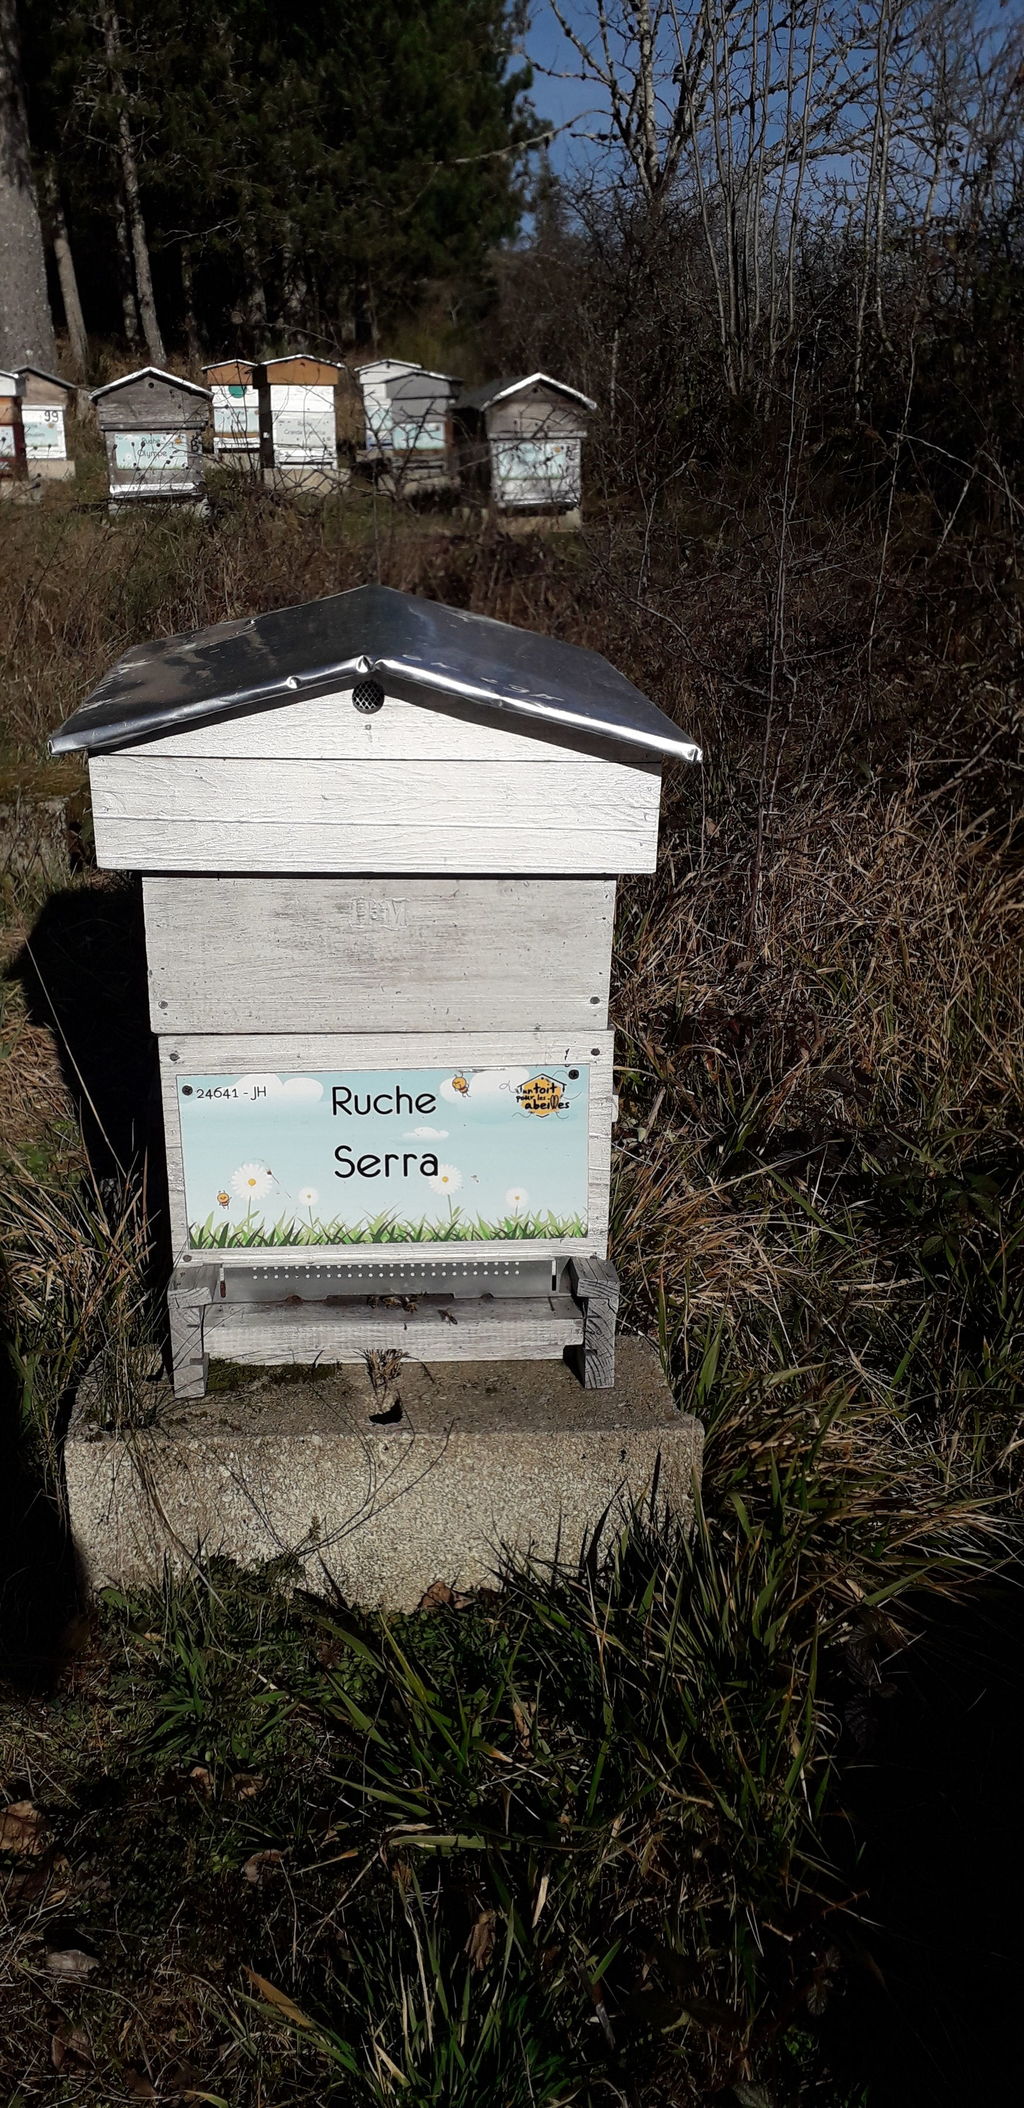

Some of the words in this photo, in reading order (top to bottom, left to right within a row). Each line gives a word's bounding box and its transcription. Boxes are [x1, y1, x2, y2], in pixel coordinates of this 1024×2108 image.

[137, 449, 167, 459] Olympe
[196, 1086, 239, 1100] 24641
[250, 1086, 267, 1101] JH
[533, 1082, 558, 1095] toit
[331, 1085, 437, 1116] Ruche
[515, 1095, 534, 1103] pour
[524, 1094, 570, 1110] abeilles
[334, 1144, 439, 1178] Serra
